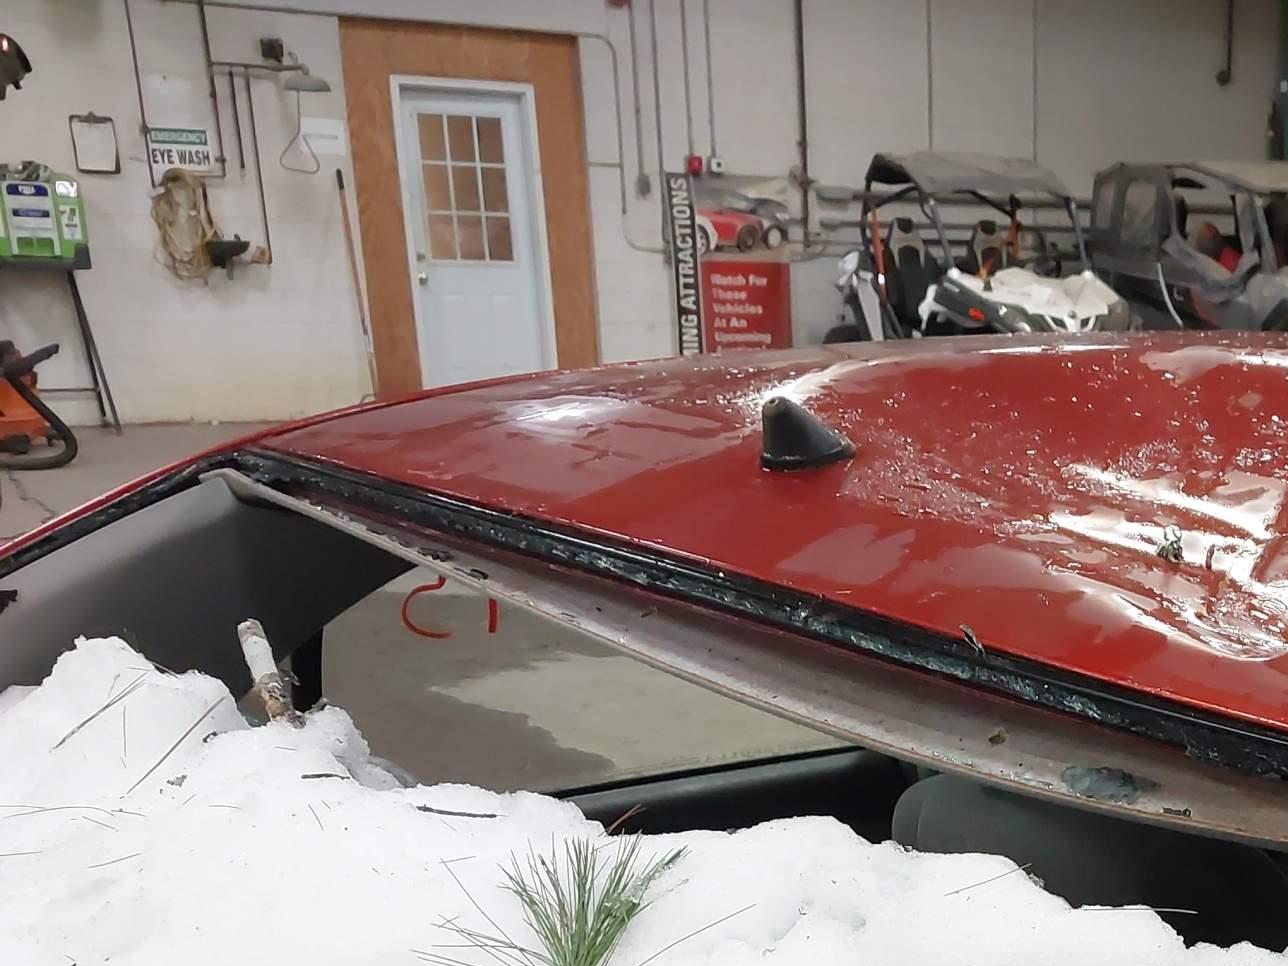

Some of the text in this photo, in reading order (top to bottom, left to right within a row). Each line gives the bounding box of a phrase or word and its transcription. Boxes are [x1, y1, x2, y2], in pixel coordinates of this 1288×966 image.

[152, 148, 211, 166] EYE WASH
[671, 177, 697, 310] ATTRACTIONS
[712, 302, 763, 315] Vehicles
